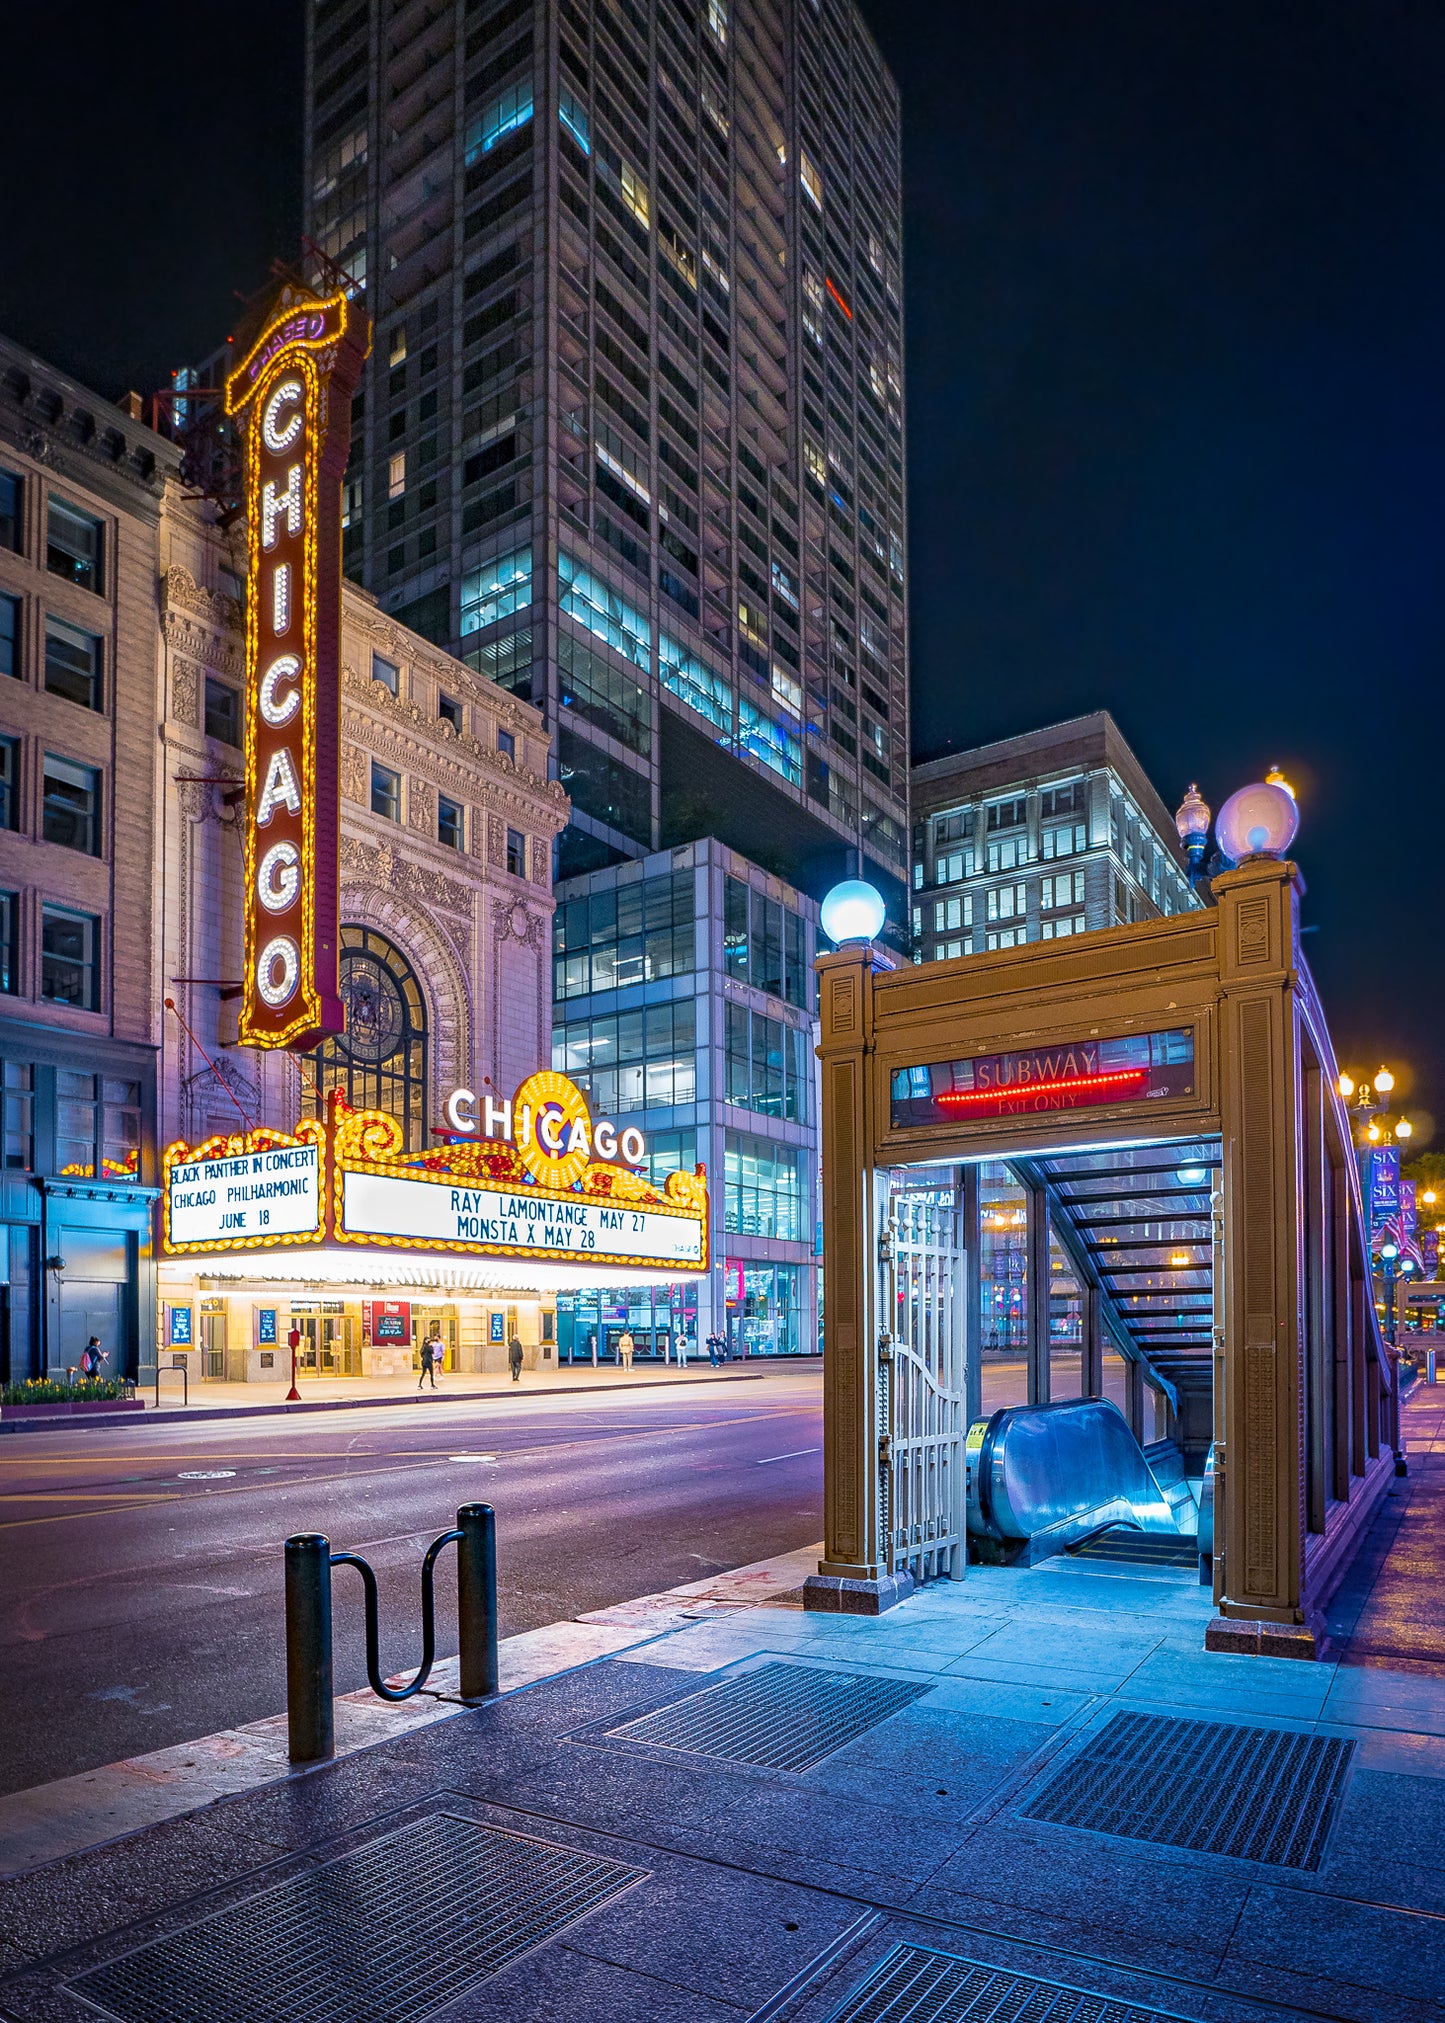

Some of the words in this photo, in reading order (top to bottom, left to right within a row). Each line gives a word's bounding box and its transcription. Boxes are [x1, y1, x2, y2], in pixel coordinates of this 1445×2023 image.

[256, 380, 304, 1008] CHICAGO
[978, 1050, 1097, 1089] SUBWAY
[998, 1098, 1028, 1115] EXIT
[1034, 1094, 1078, 1112] ONLY
[448, 1088, 645, 1165] CHICAGO
[171, 1164, 200, 1185] BLACK
[204, 1156, 249, 1180] PANTHER
[252, 1156, 263, 1175] IN
[266, 1149, 316, 1172] CONCERT
[174, 1189, 216, 1209] CHICAGO
[227, 1177, 309, 1203] PHILHARMONIC
[219, 1211, 247, 1230] JUNE
[259, 1209, 270, 1226] 18
[451, 1190, 482, 1214] RAY
[499, 1196, 588, 1226] LAMONTANGE
[600, 1210, 625, 1232] MAY
[632, 1214, 646, 1233] 27
[457, 1216, 518, 1243] MONSTA
[526, 1223, 536, 1244] X
[544, 1226, 573, 1248] MAY
[580, 1230, 596, 1249] 28
